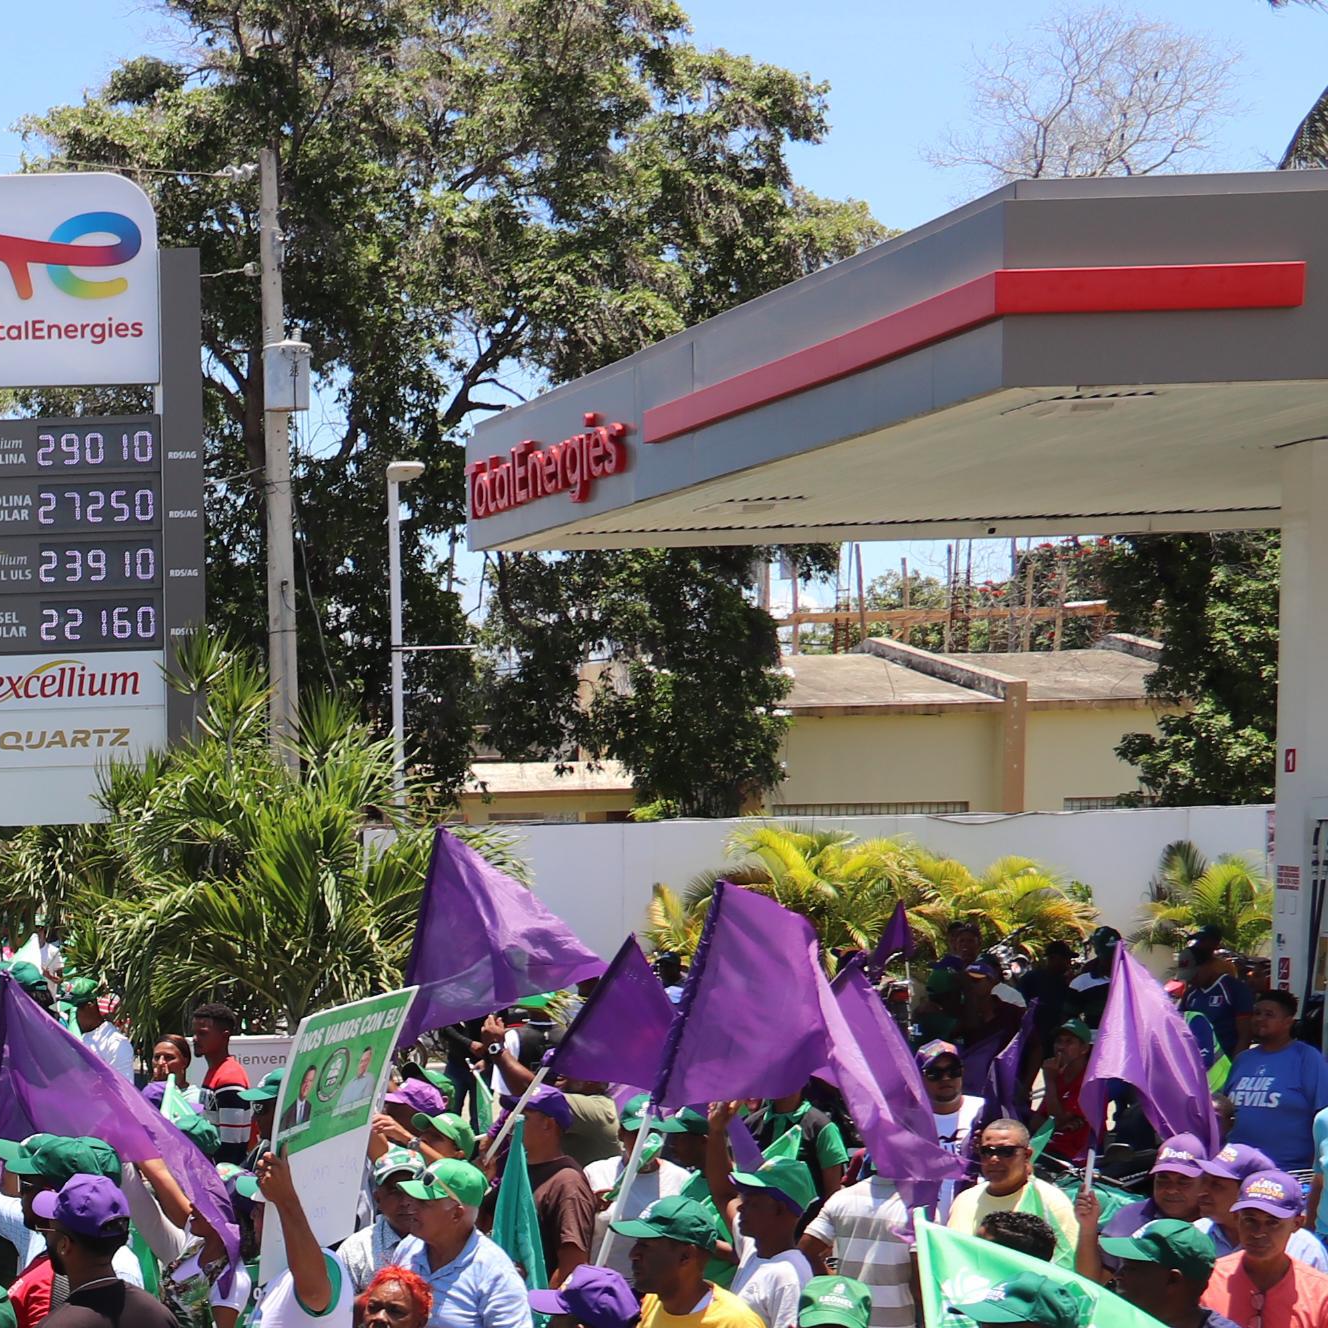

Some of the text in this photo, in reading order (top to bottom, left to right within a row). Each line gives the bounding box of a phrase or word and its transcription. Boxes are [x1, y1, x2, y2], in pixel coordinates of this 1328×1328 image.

[464, 412, 627, 520] TotalEnergies
[9, 569, 32, 581] ULS
[324, 1017, 361, 1046] VAMOS
[360, 1011, 384, 1036] CON
[1236, 1076, 1277, 1091] BLUE
[1228, 1091, 1282, 1108] DEVILS
